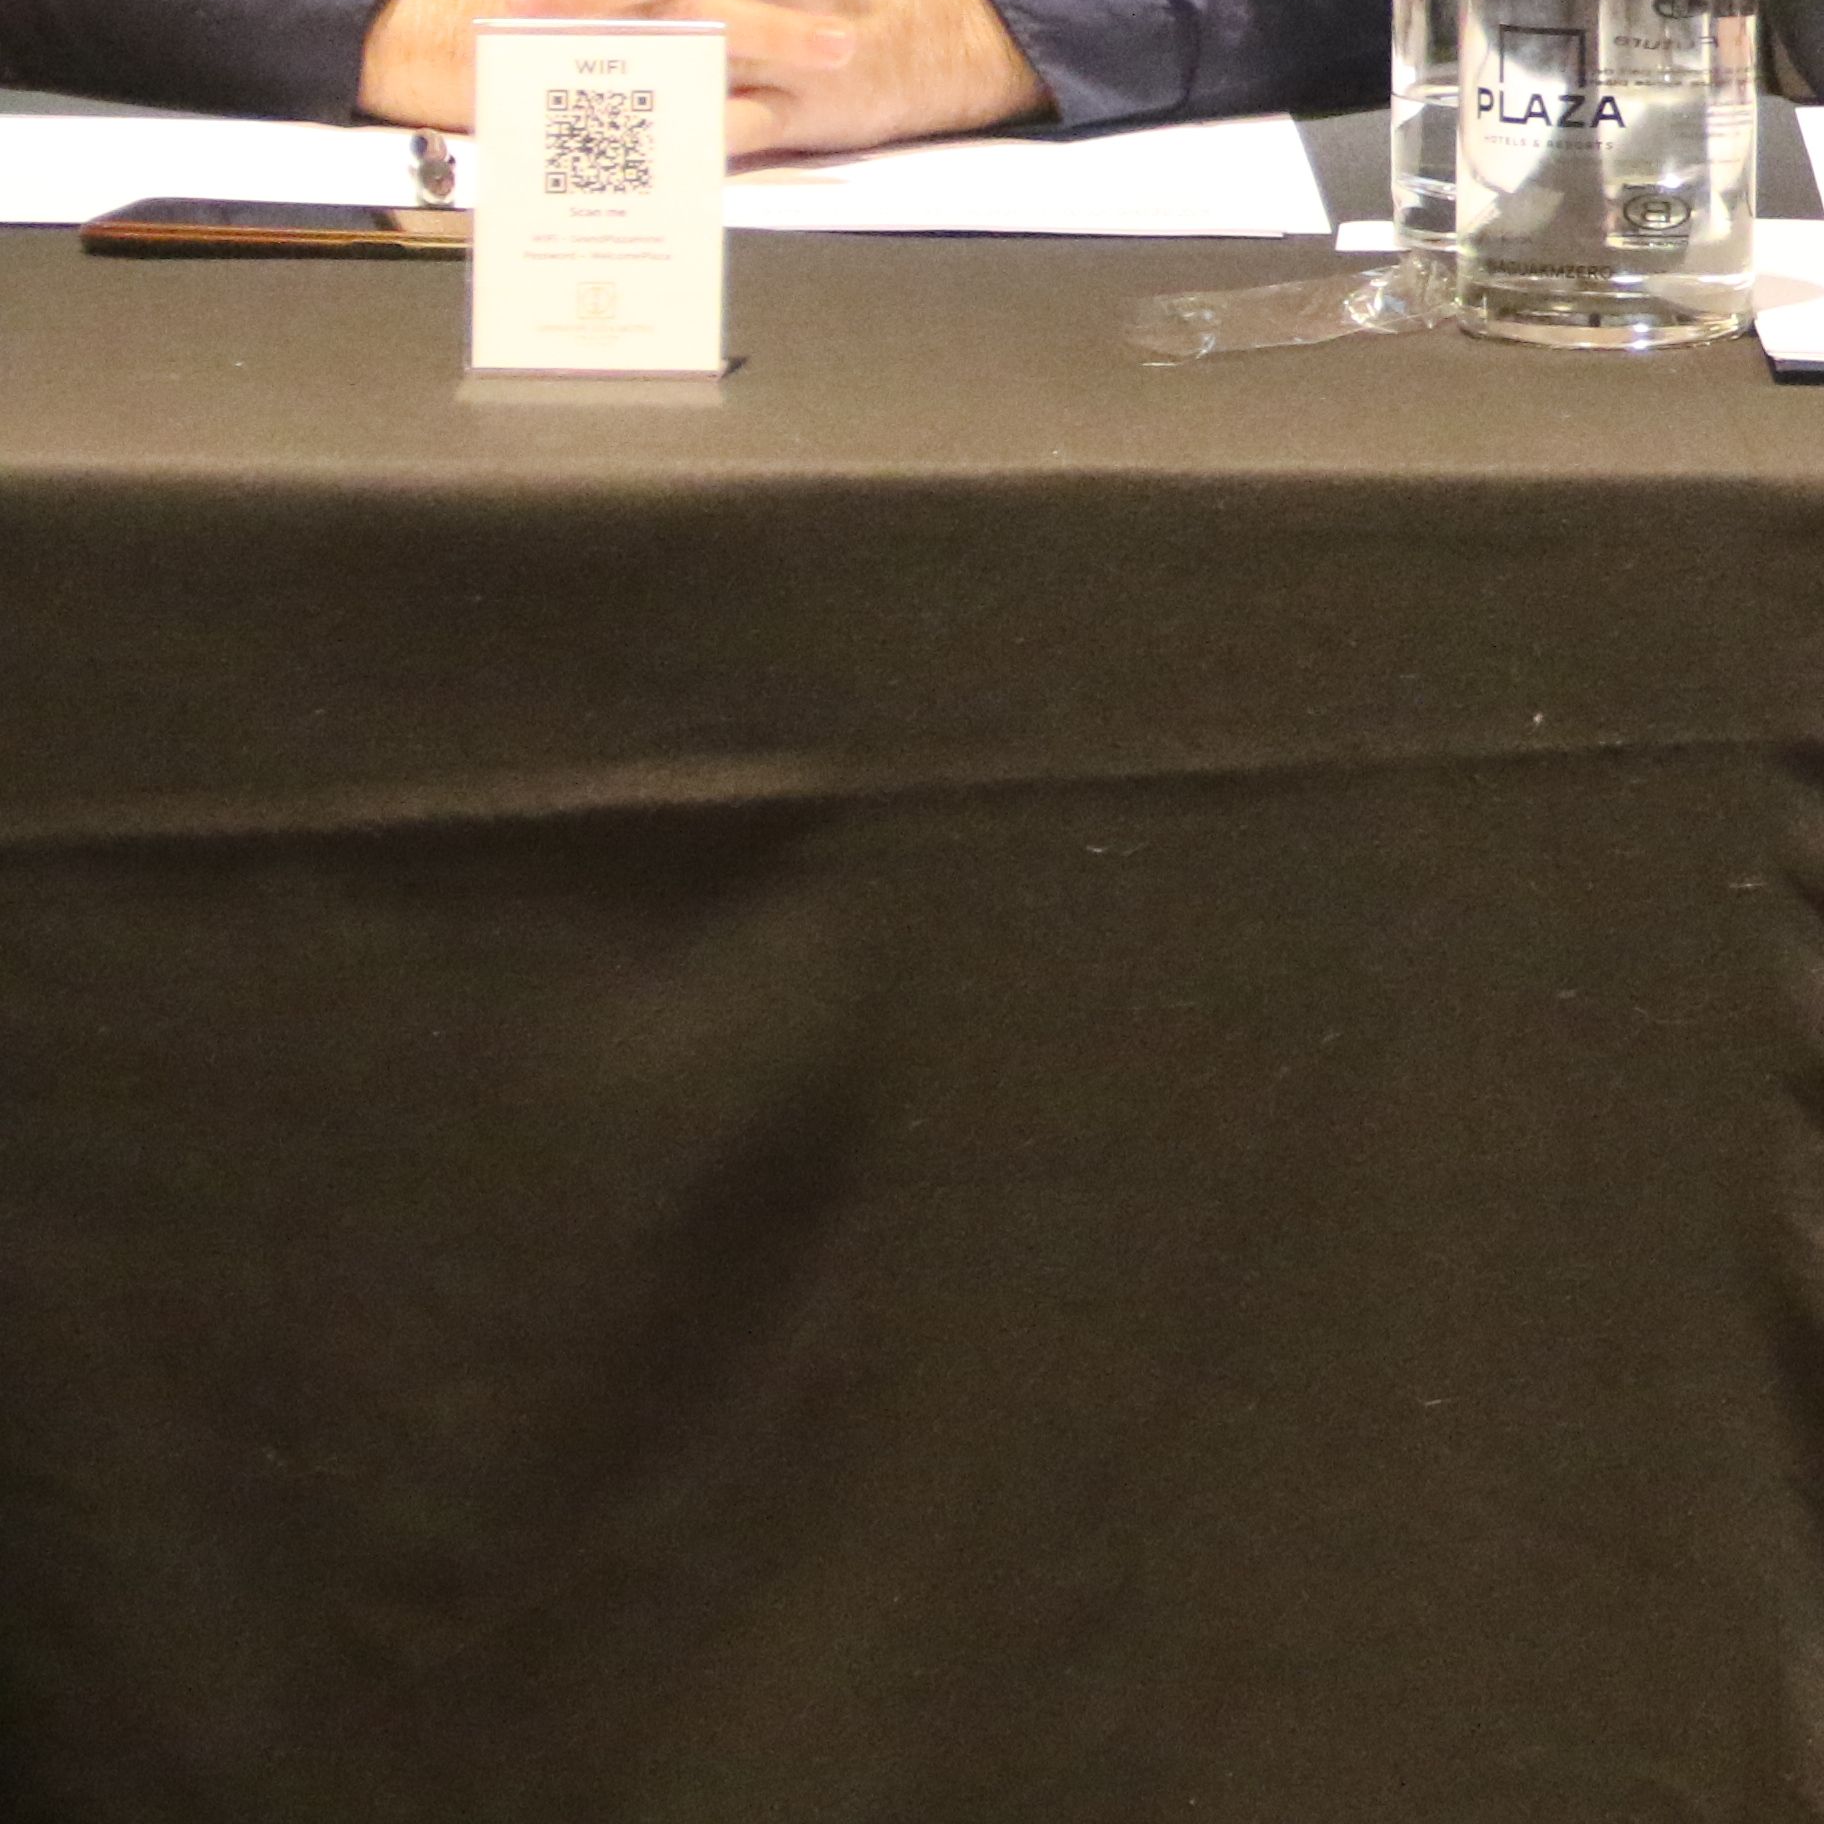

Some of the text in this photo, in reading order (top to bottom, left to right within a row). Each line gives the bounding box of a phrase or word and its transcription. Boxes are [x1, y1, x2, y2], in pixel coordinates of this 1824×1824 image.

[575, 59, 627, 74] WIFI
[1477, 87, 1625, 128] PLAZA
[569, 207, 601, 218] Scan
